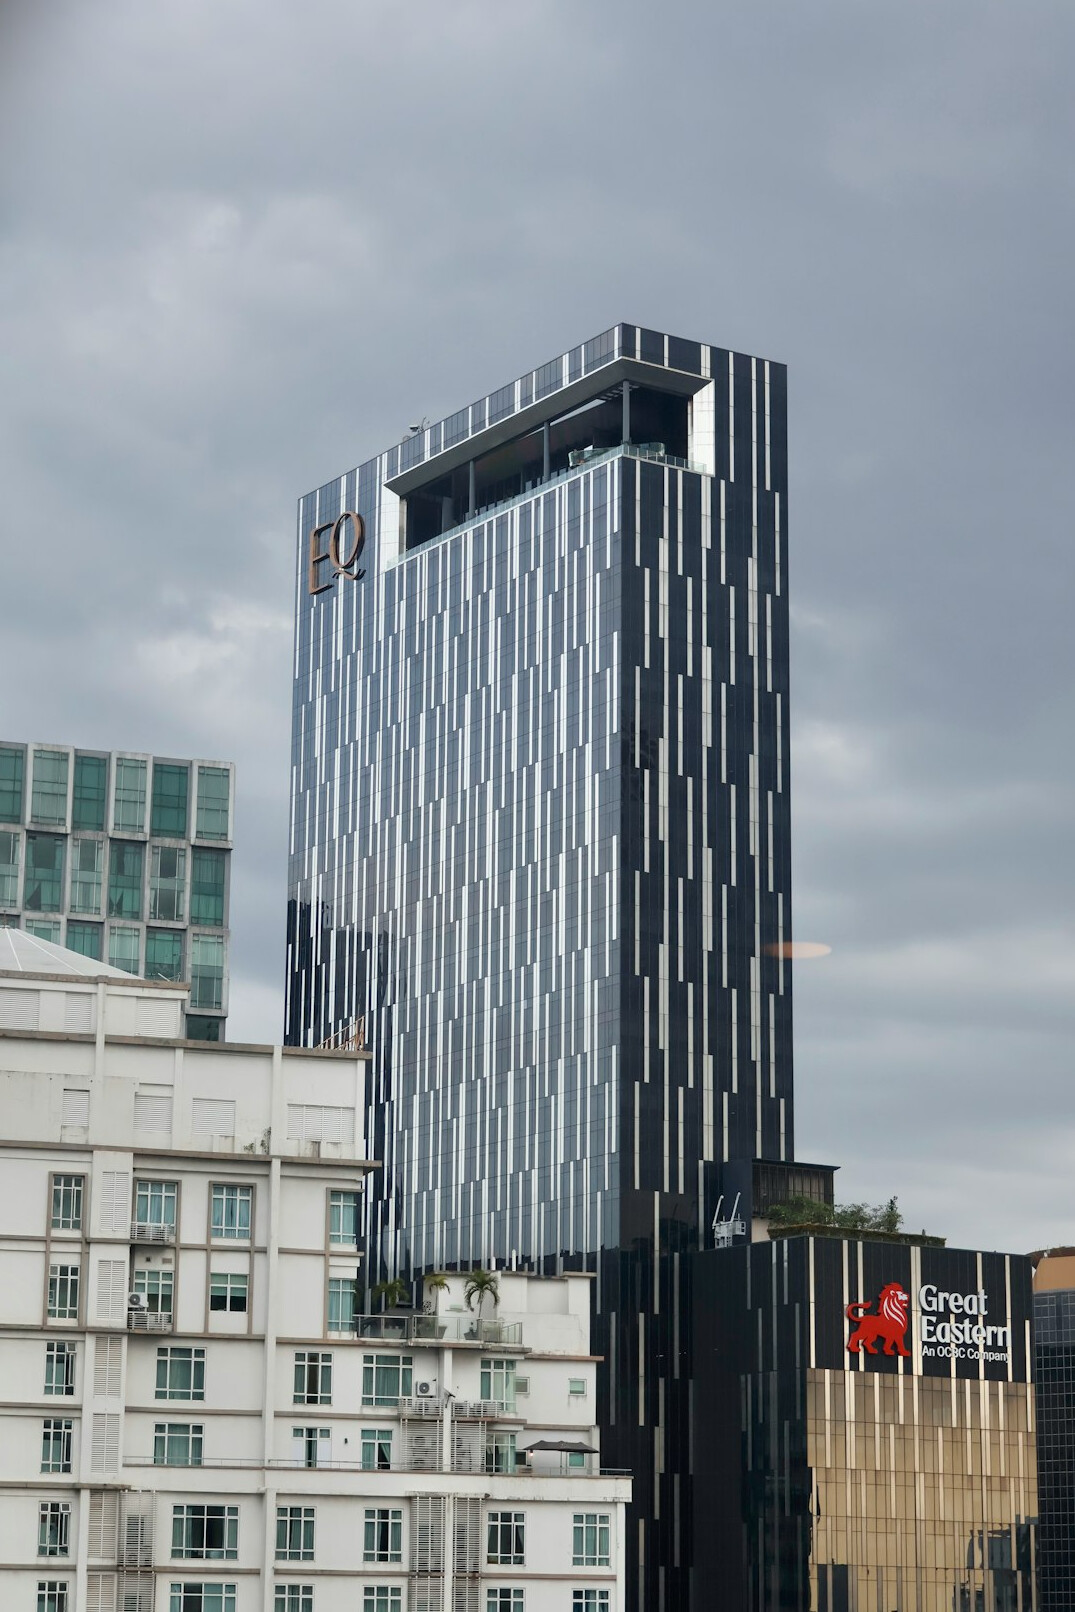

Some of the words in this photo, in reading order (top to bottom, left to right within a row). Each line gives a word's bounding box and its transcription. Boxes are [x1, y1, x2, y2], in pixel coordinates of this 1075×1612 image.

[309, 511, 366, 595] EQ
[919, 1284, 988, 1315] Great
[921, 1315, 1011, 1347] Eastern
[921, 1345, 936, 1357] An
[938, 1346, 966, 1358] OCBC
[967, 1348, 1010, 1363] Company
